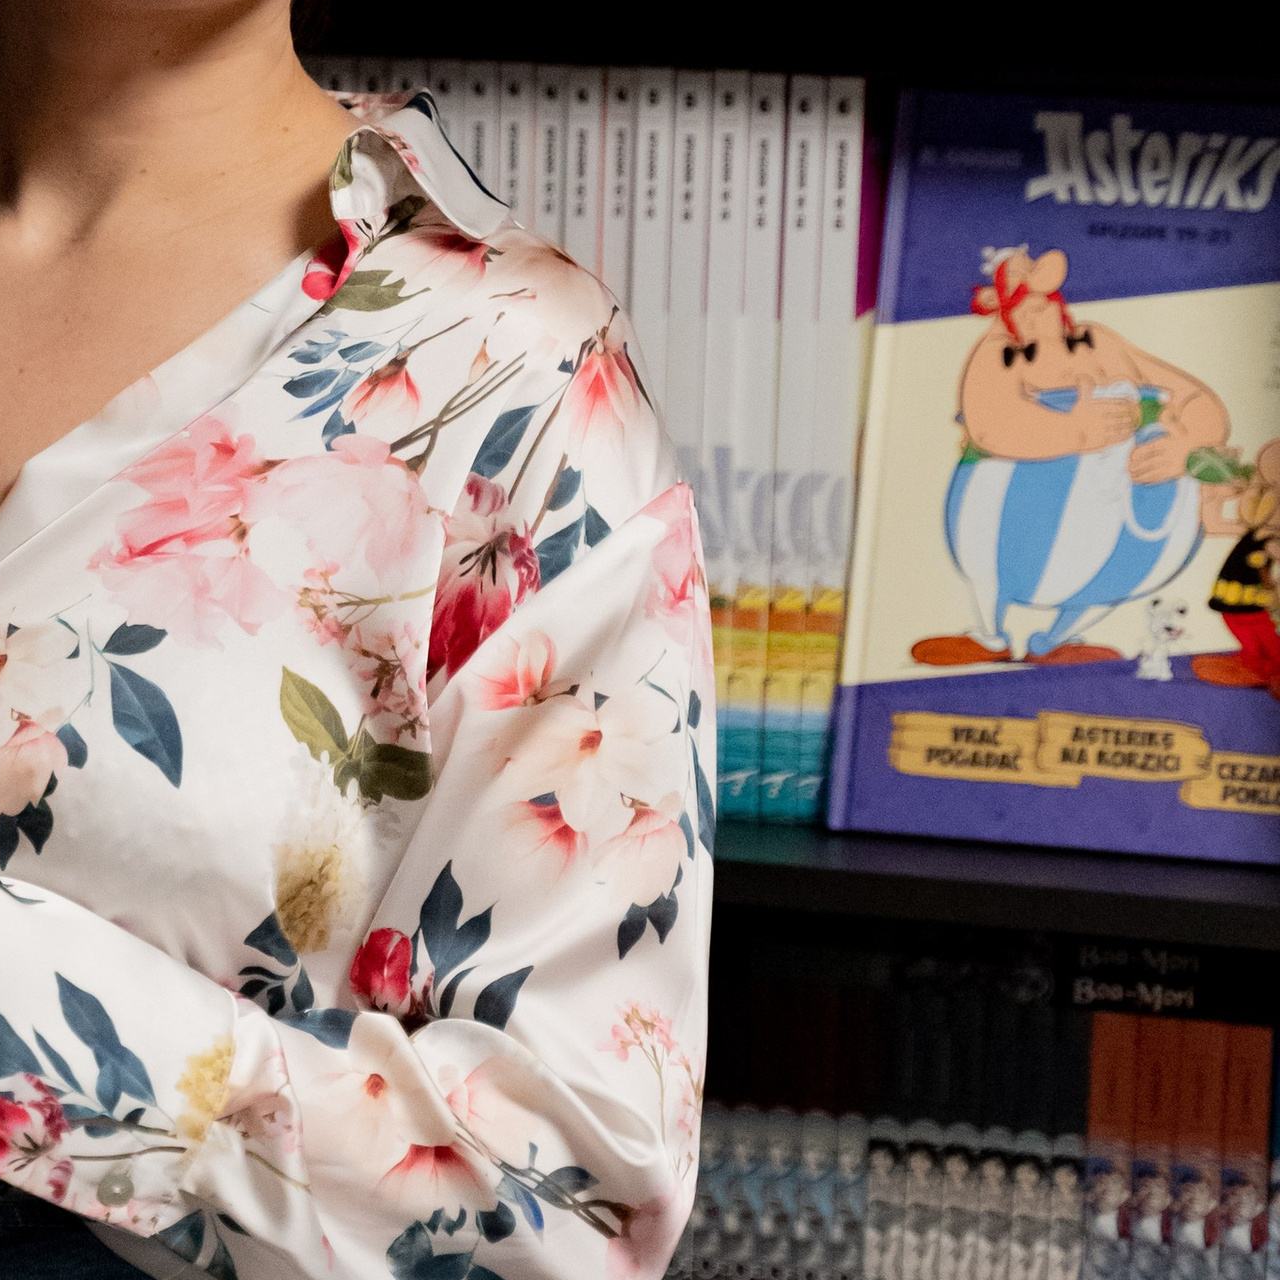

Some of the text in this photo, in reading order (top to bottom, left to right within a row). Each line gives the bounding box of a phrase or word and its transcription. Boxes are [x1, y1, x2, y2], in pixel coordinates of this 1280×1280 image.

[1025, 110, 1280, 212] Asteriks
[1072, 726, 1174, 749] ASTERIKS
[1061, 748, 1088, 766] NA
[1072, 976, 1195, 1012] Boa-Mori
